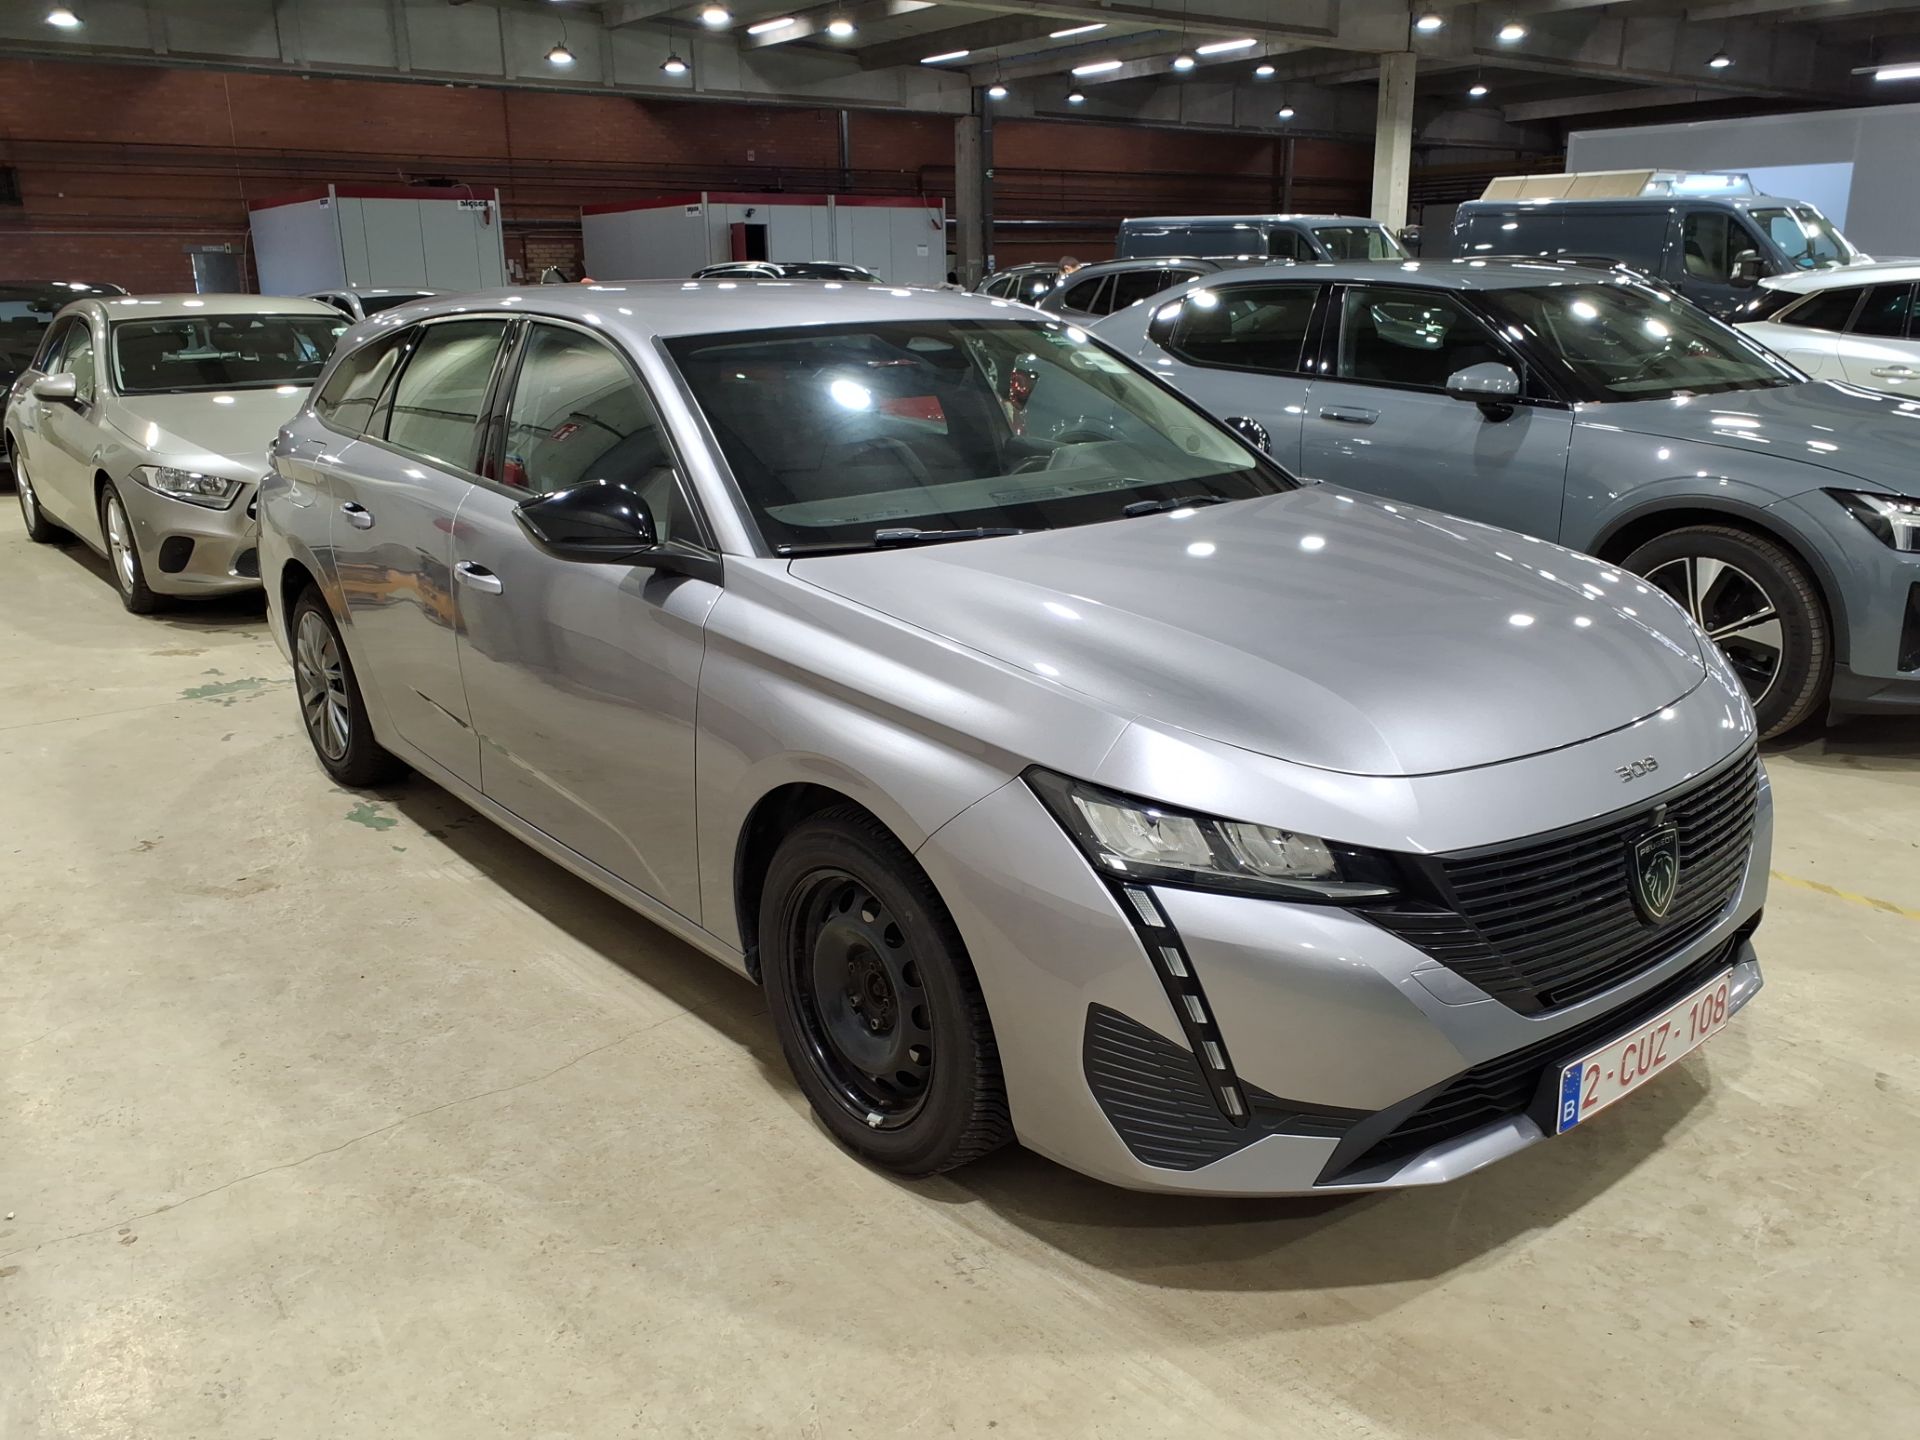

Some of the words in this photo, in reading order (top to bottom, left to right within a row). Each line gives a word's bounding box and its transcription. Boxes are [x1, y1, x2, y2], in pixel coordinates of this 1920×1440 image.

[1614, 755, 1659, 783] 308
[1639, 835, 1674, 857] PEUGEOT
[1563, 1099, 1575, 1122] B
